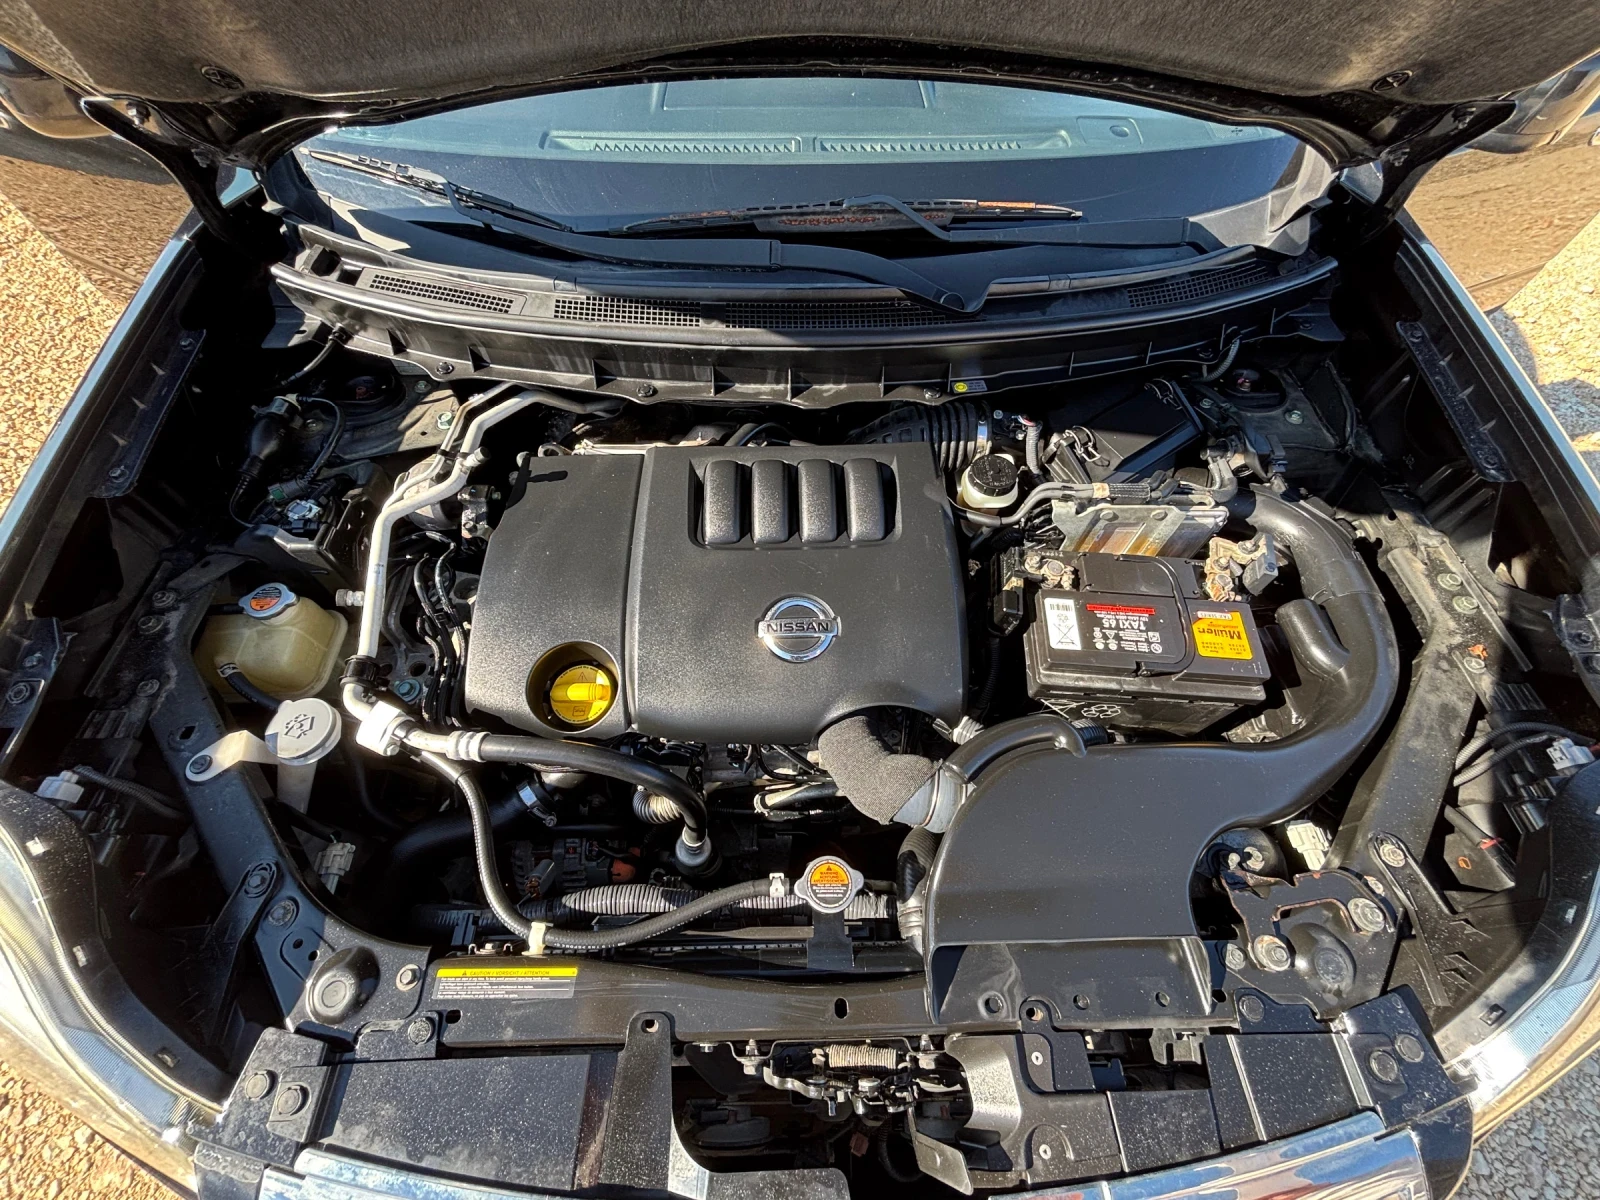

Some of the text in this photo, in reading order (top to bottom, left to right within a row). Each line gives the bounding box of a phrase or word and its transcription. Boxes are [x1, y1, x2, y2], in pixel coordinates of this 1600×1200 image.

[766, 621, 829, 633] NISSAN
[1102, 618, 1147, 630] TAXI 65
[1198, 627, 1242, 640] Müller
